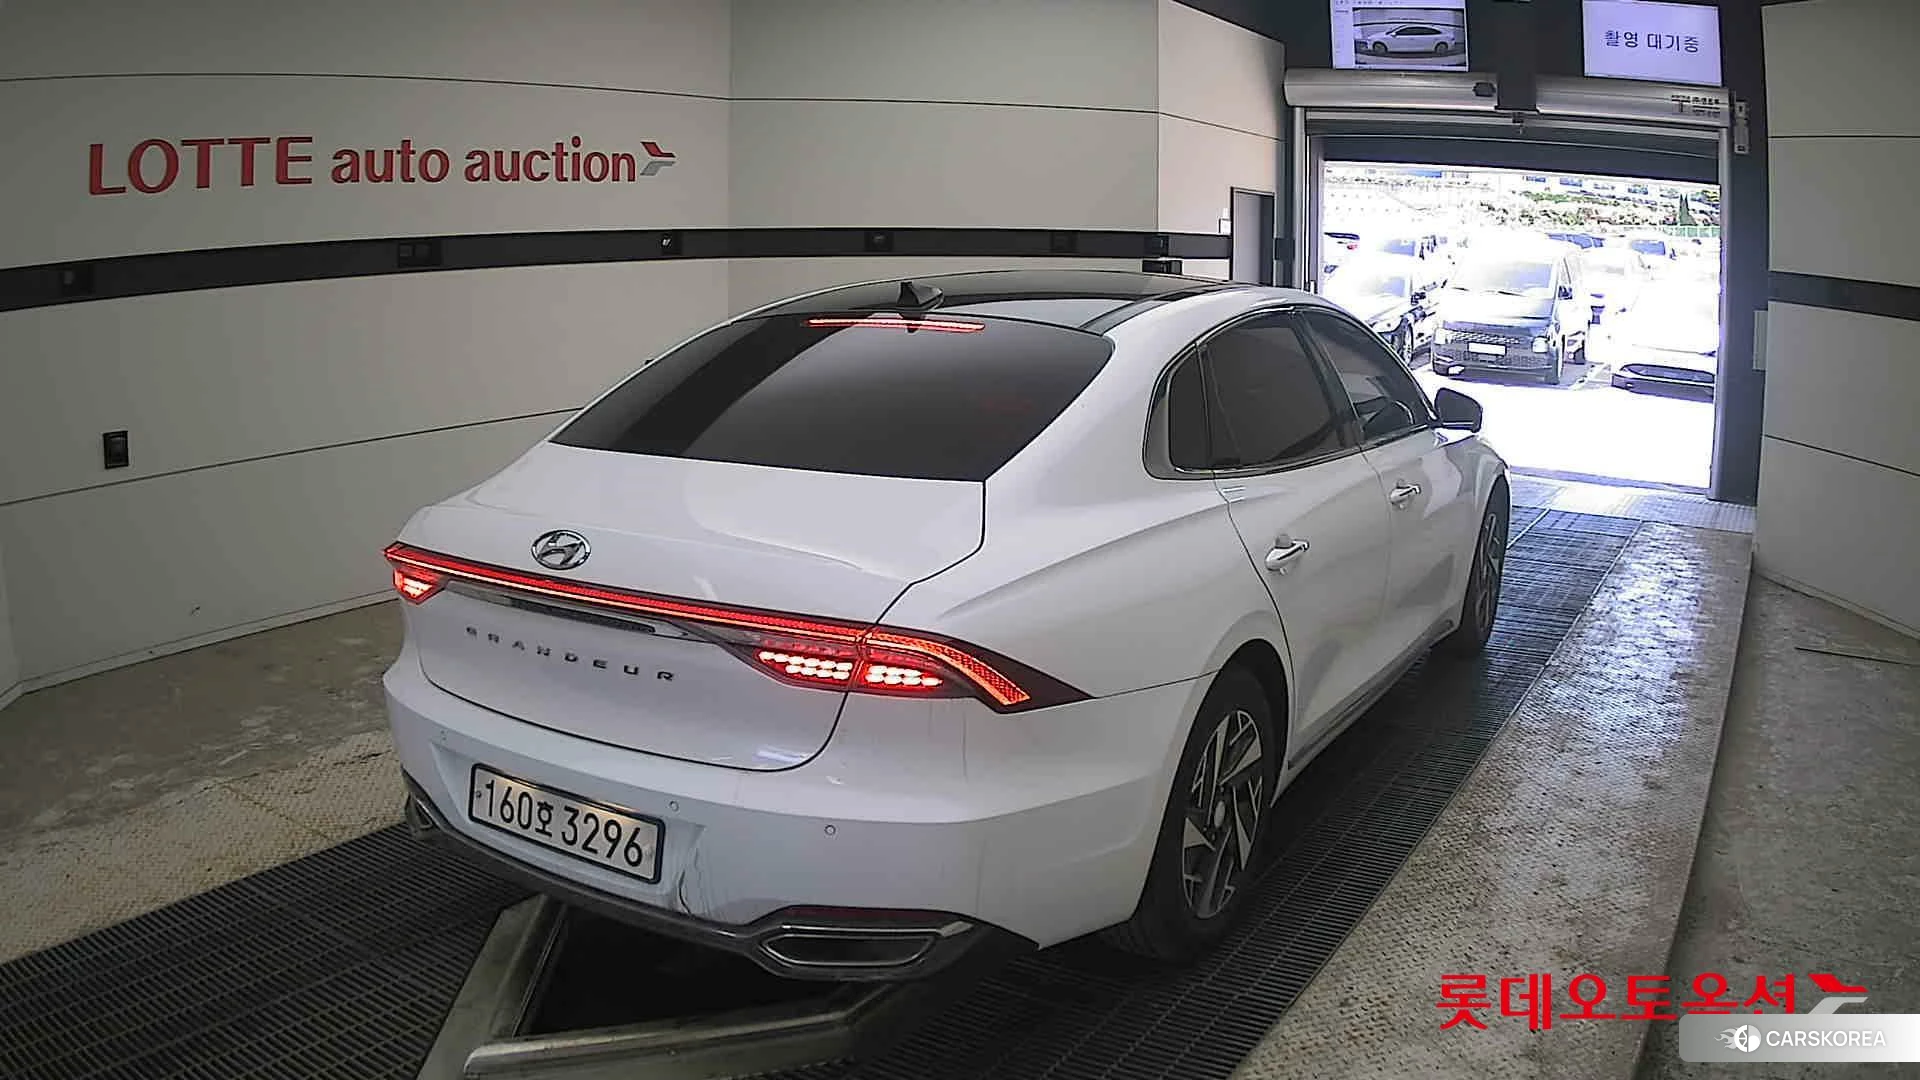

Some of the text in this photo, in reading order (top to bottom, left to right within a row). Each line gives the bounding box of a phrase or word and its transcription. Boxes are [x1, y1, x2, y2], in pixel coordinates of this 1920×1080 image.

[1647, 33, 1699, 53] 대기중
[89, 136, 636, 196] LOTTE auto auction
[465, 626, 675, 681] GRANDEUR
